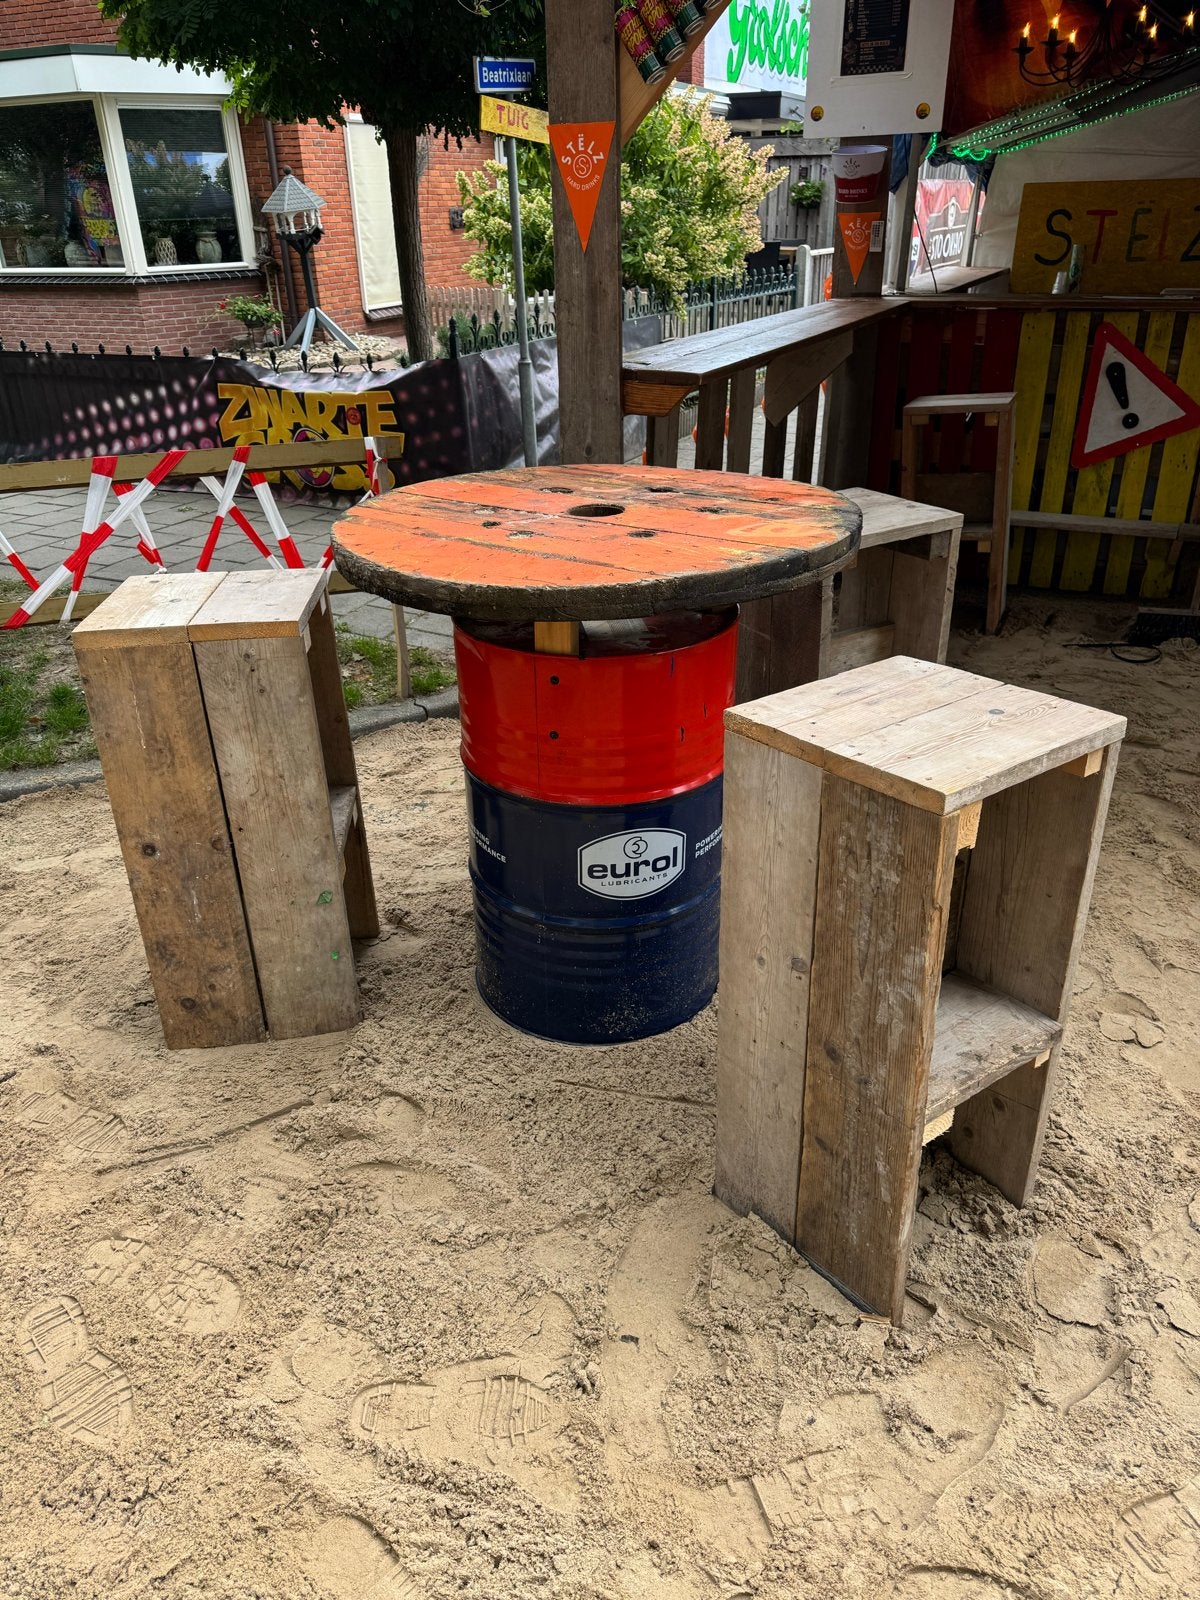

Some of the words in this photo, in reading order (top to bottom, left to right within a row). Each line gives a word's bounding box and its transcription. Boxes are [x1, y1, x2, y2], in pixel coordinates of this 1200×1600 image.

[482, 67, 532, 83] Beatrixlaan
[561, 133, 604, 166] STËLZ
[587, 846, 678, 880] eurol
[601, 872, 668, 887] LUBRICANTS
